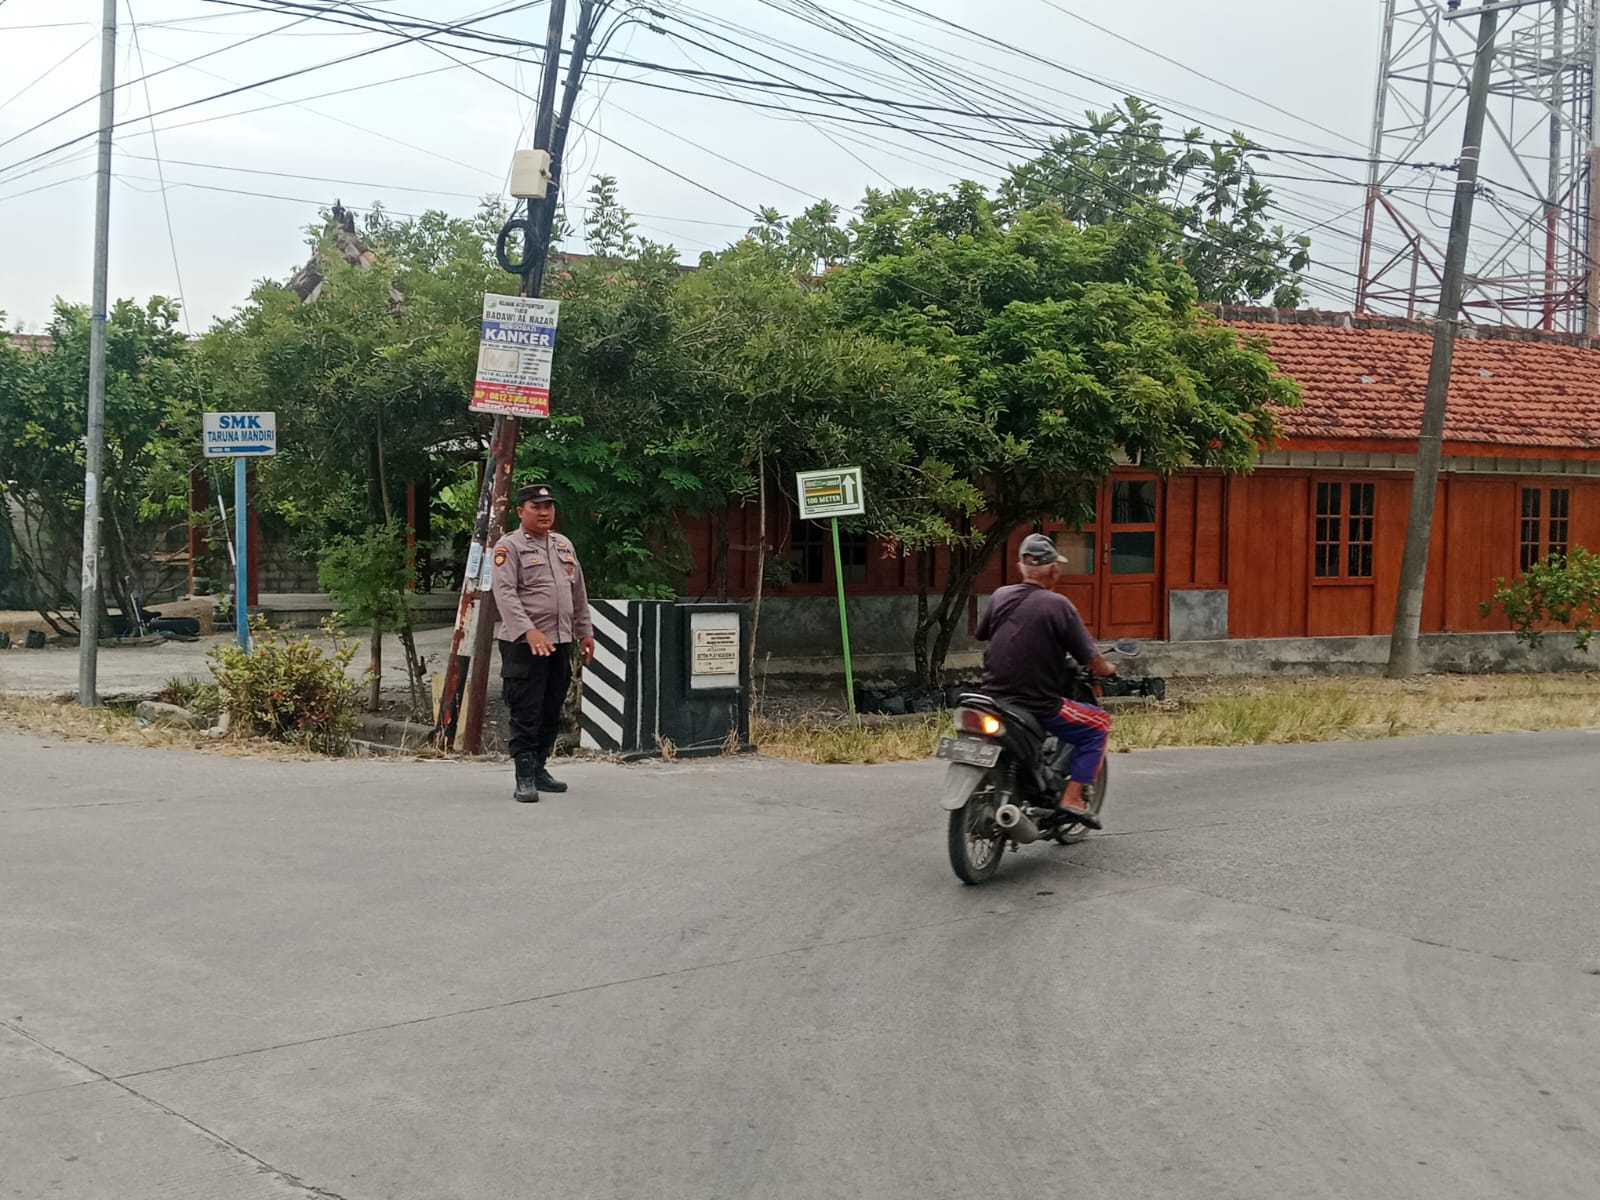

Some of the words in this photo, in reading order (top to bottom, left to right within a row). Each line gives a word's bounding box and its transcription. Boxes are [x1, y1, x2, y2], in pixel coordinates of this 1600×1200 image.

[486, 311, 515, 321] BADAWI
[517, 314, 526, 322] AL
[530, 315, 554, 325] NAZAR
[485, 328, 550, 346] KANKER
[219, 415, 261, 429] SMK
[207, 431, 239, 442] TARUNA
[241, 430, 274, 441] MANDIRI
[819, 495, 841, 503] METER
